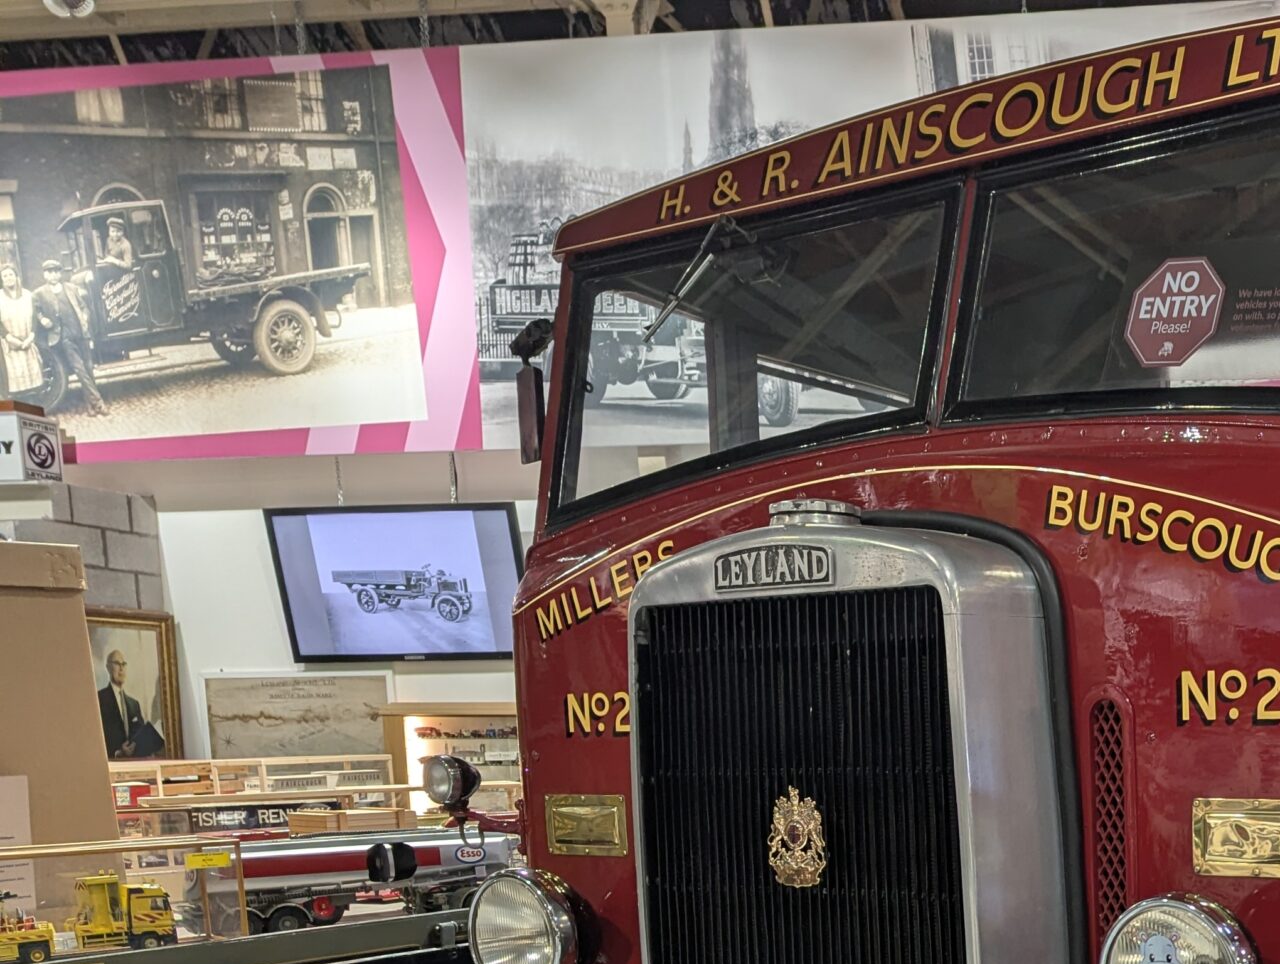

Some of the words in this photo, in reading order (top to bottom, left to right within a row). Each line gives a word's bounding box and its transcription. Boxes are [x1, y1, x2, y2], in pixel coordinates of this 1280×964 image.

[660, 184, 691, 220] H.
[713, 170, 742, 207] &
[762, 150, 799, 197] R.
[817, 46, 1186, 184] AINSCOUGH
[1162, 270, 1200, 294] NO
[495, 287, 560, 315] HIGHLAN
[1254, 288, 1273, 297] have
[1138, 294, 1217, 319] ENTRY
[1235, 299, 1267, 310] vehicles
[1150, 320, 1191, 335] Please!
[715, 548, 828, 588] LEYLAND
[192, 810, 247, 827] FISHER
[460, 849, 482, 858] Esso
